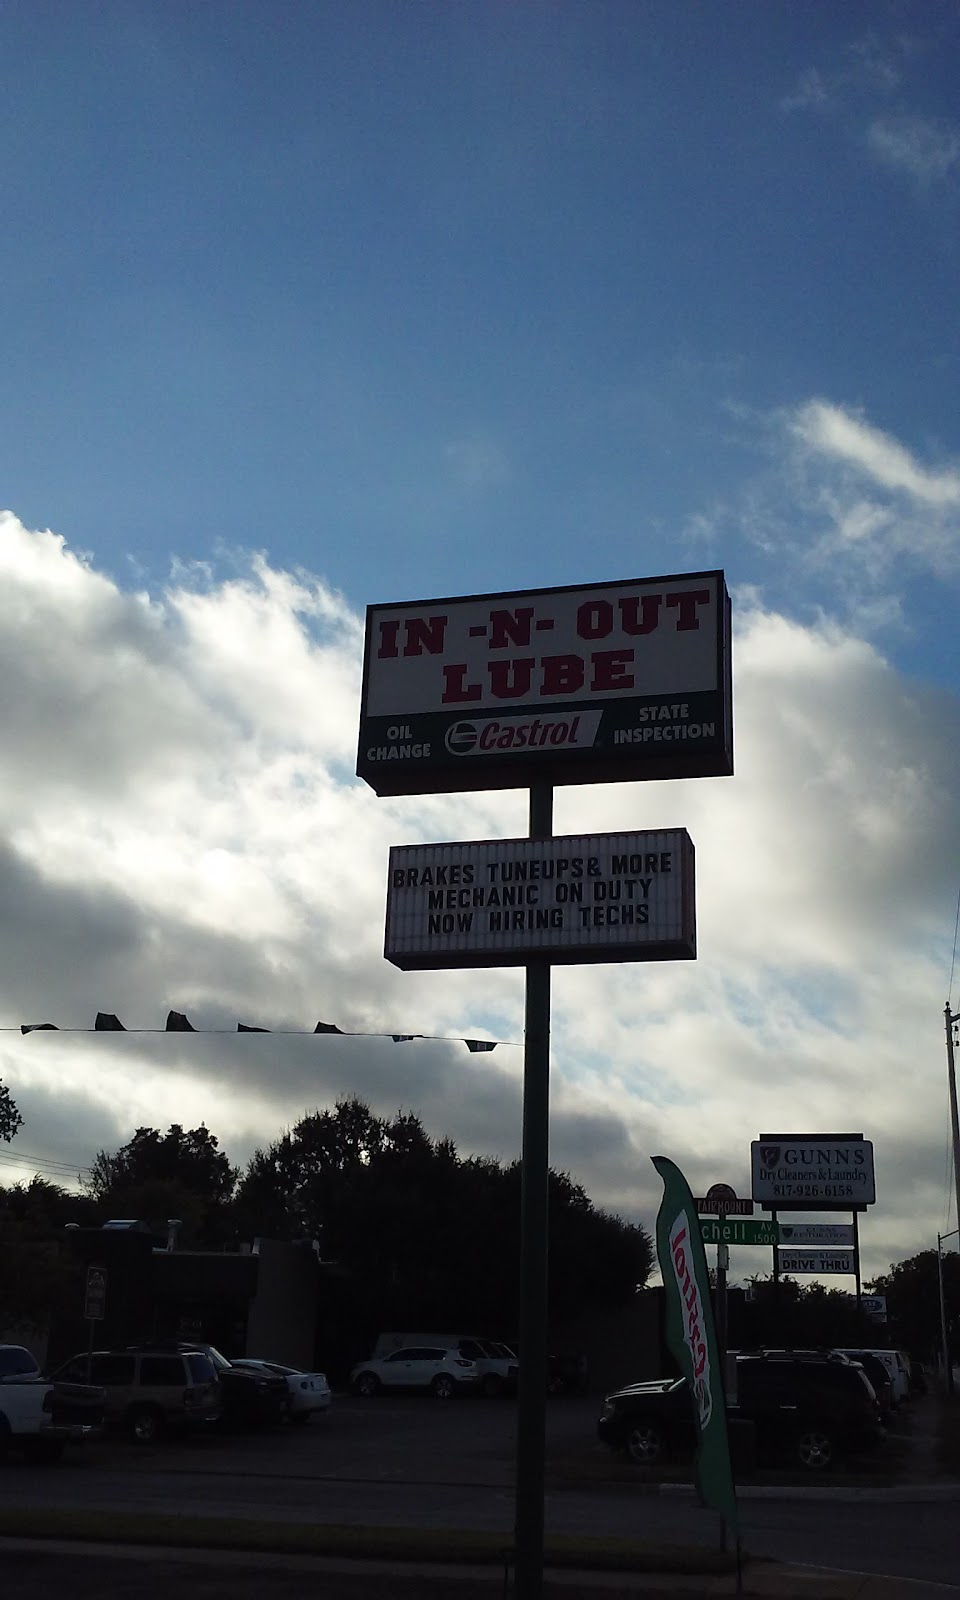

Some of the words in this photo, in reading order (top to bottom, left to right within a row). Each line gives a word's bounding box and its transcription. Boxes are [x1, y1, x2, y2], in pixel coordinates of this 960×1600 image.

[377, 615, 448, 659] IN
[577, 589, 710, 640] OUT
[441, 648, 635, 704] LUBE
[639, 703, 690, 722] STATE
[386, 725, 413, 741] OIL
[479, 716, 581, 751] Castrol
[614, 722, 715, 745] INSPECTION
[367, 743, 431, 761] CHANGE
[393, 863, 474, 888] BRAKES
[611, 852, 672, 875] MORE
[428, 884, 539, 910] MECHANIC
[555, 882, 583, 903] ON
[594, 878, 653, 901] DUTY
[428, 913, 473, 935] NOW
[489, 908, 564, 932] HIRING
[579, 903, 650, 927] TECHS
[783, 1148, 866, 1166] GUNNS
[759, 1168, 776, 1184] Dry
[777, 1167, 817, 1181] Cleaners
[828, 1167, 868, 1184] Laundry
[773, 1184, 853, 1197] 817-926-6158
[701, 1222, 746, 1240] chell
[753, 1233, 777, 1244] 1500
[782, 1259, 815, 1270] DRIVE
[820, 1260, 850, 1271] THRU
